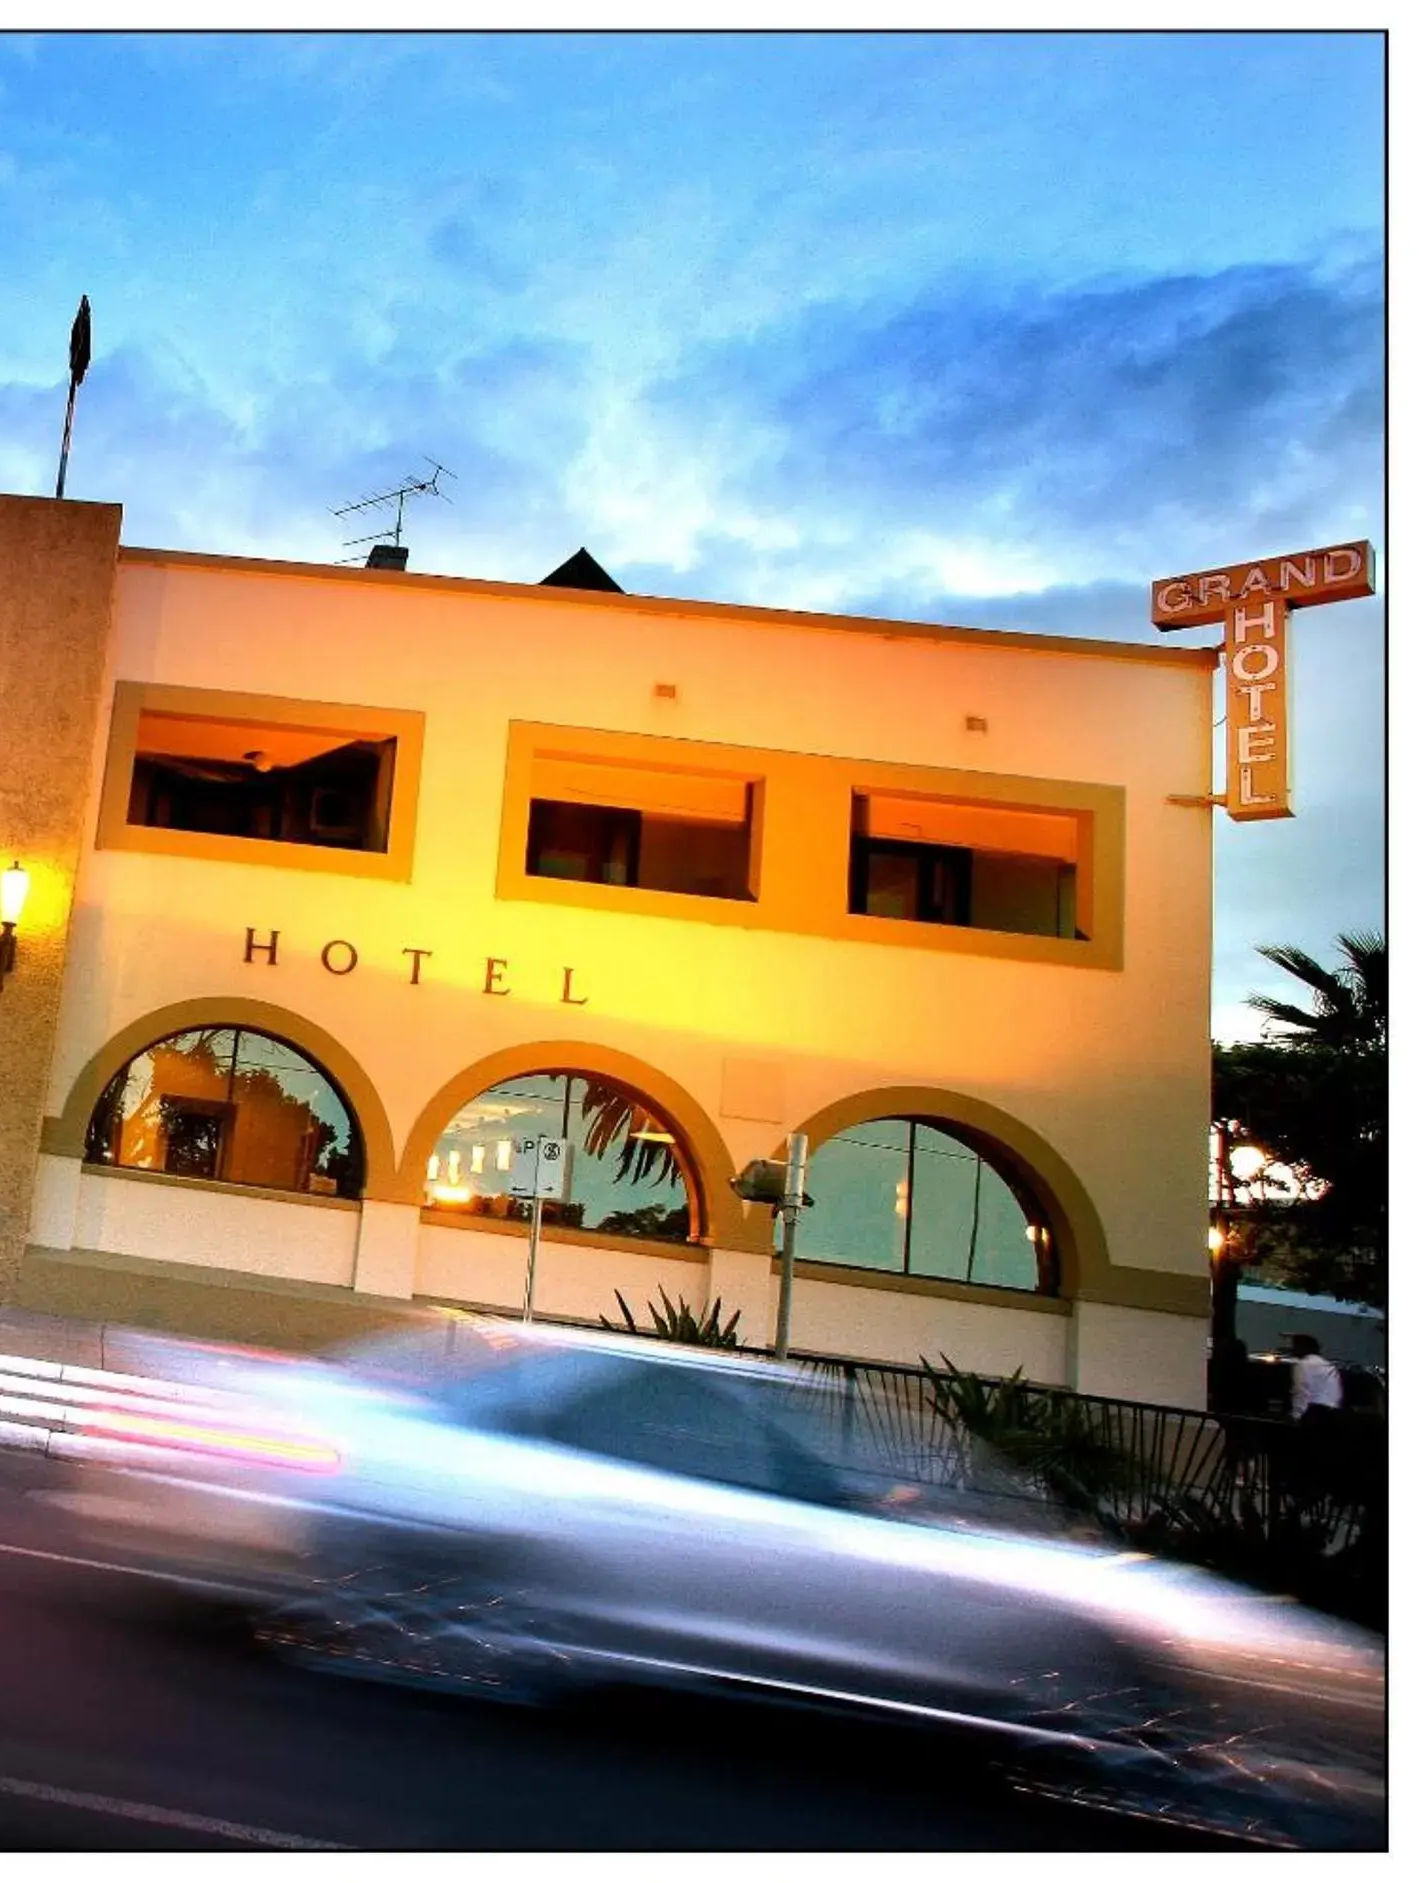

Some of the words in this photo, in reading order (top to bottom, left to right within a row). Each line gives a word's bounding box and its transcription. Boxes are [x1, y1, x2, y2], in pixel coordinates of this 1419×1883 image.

[1157, 549, 1362, 613] GRAND
[1232, 601, 1280, 806] HOTEL
[243, 926, 590, 1006] HOTEL
